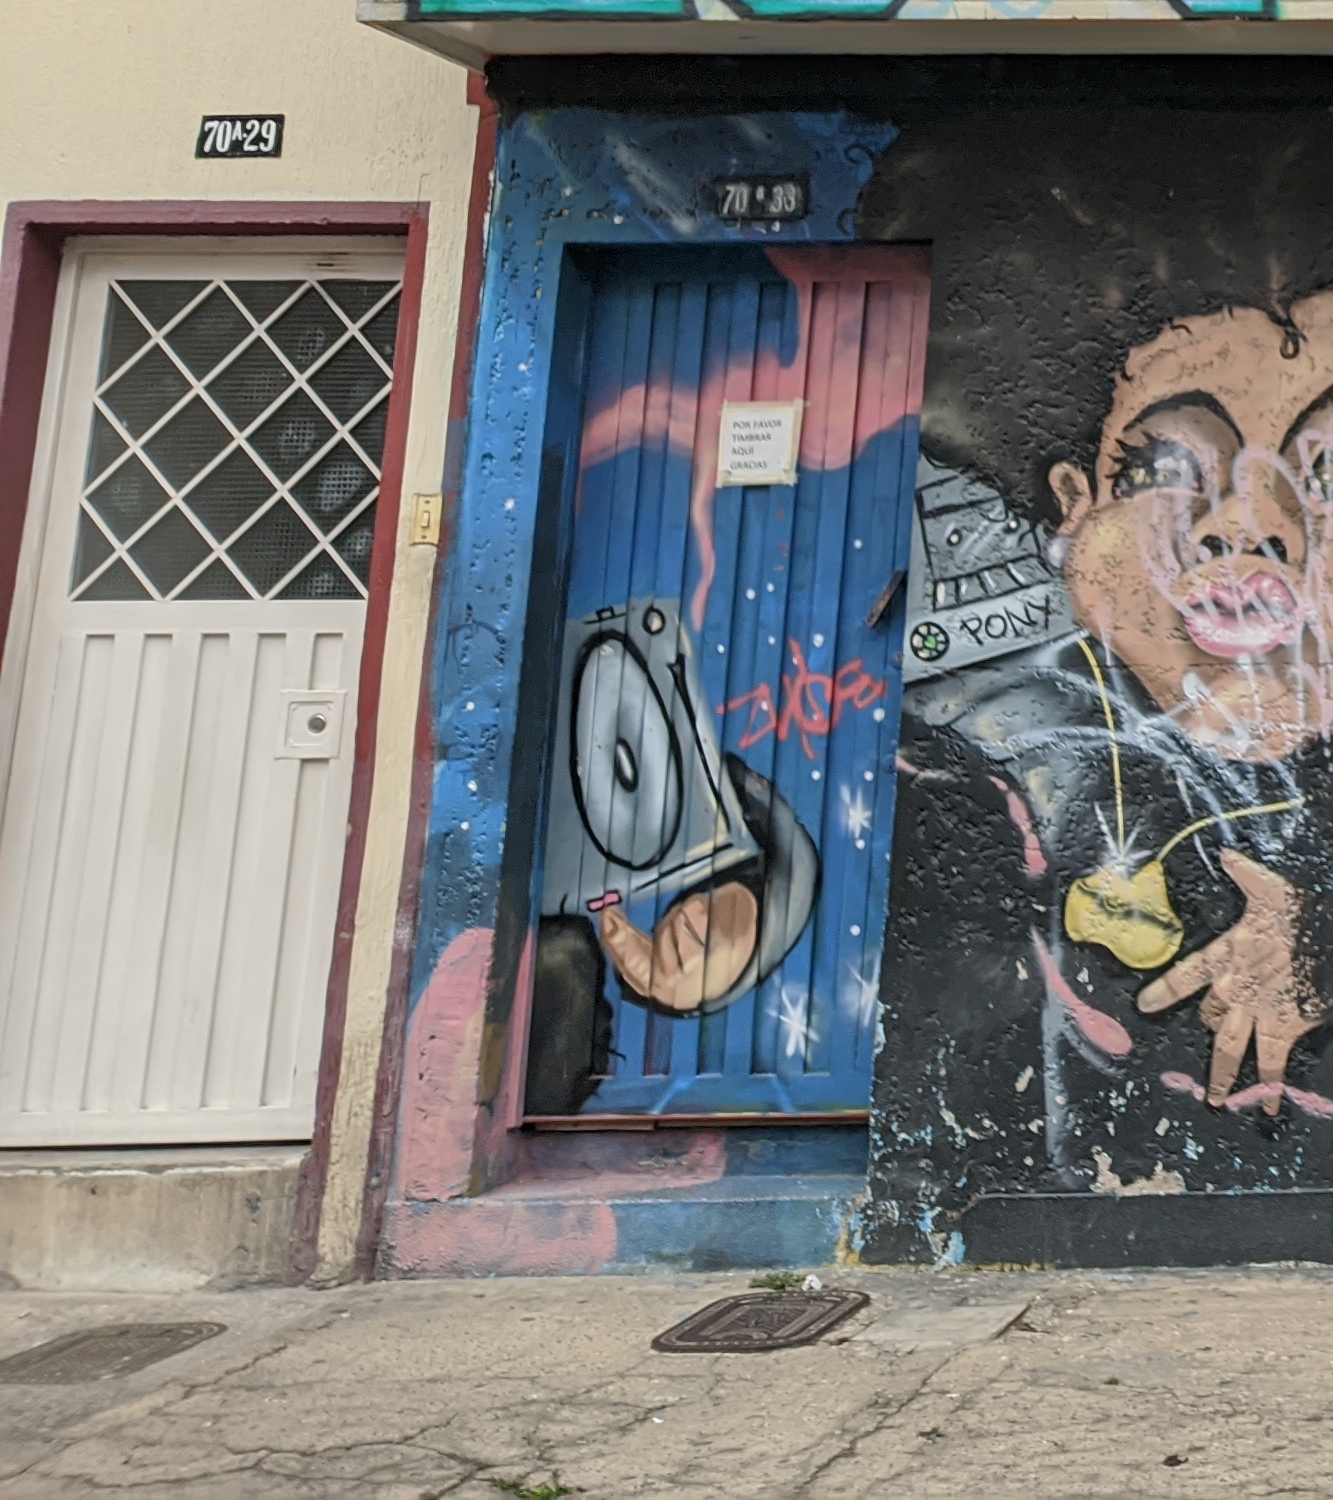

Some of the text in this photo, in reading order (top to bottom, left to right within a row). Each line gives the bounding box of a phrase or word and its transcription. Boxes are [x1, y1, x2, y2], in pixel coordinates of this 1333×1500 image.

[732, 419, 782, 430] POR FAVOR
[731, 433, 772, 442] TIMBRAR
[729, 460, 768, 470] GRACIAS
[959, 592, 1053, 647] PONY
